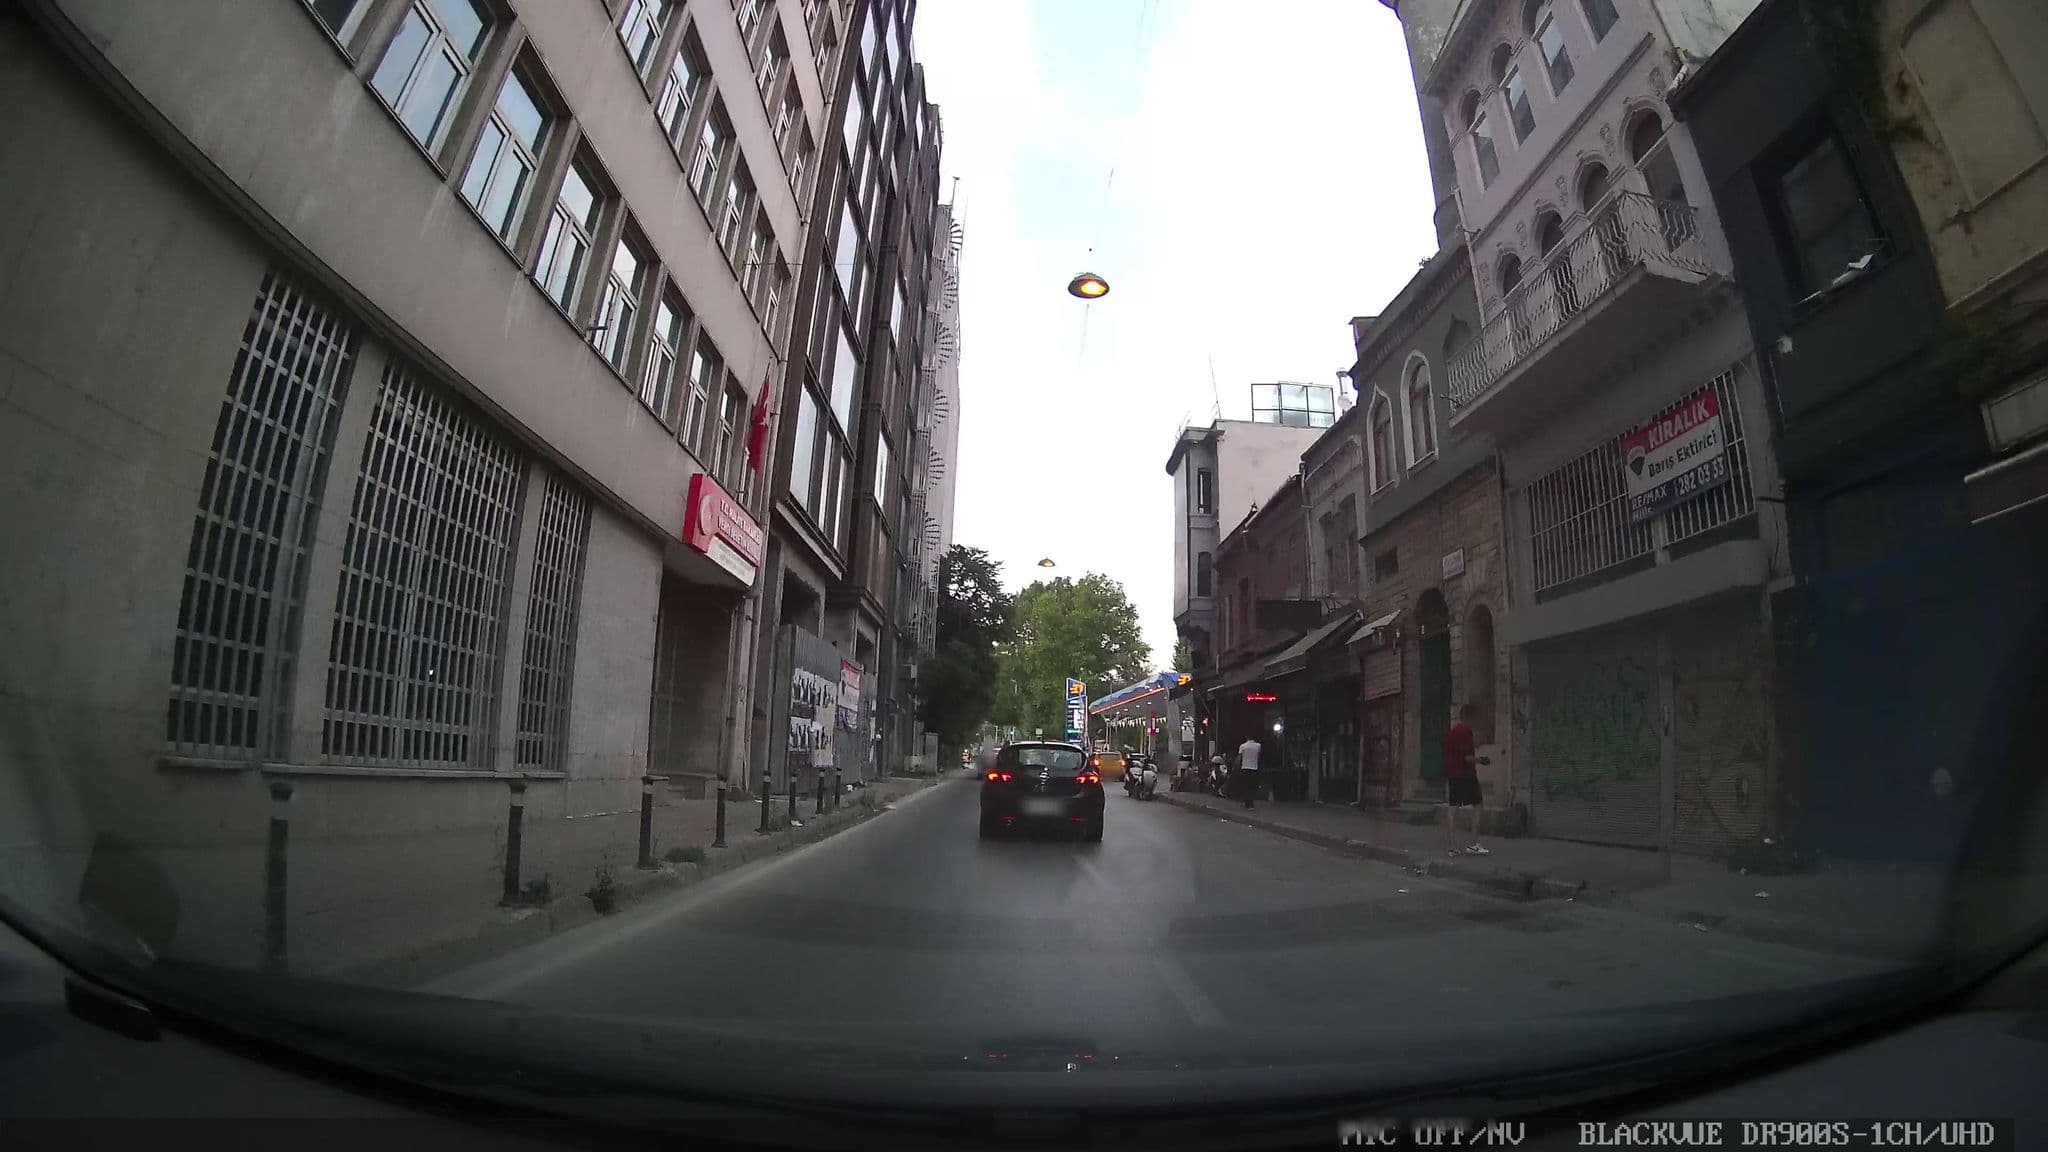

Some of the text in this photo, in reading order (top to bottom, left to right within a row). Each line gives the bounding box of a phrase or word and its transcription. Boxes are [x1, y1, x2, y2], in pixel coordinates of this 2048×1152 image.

[1648, 397, 1710, 449] KİRALIK
[1647, 429, 1717, 478] Barış Ektirici
